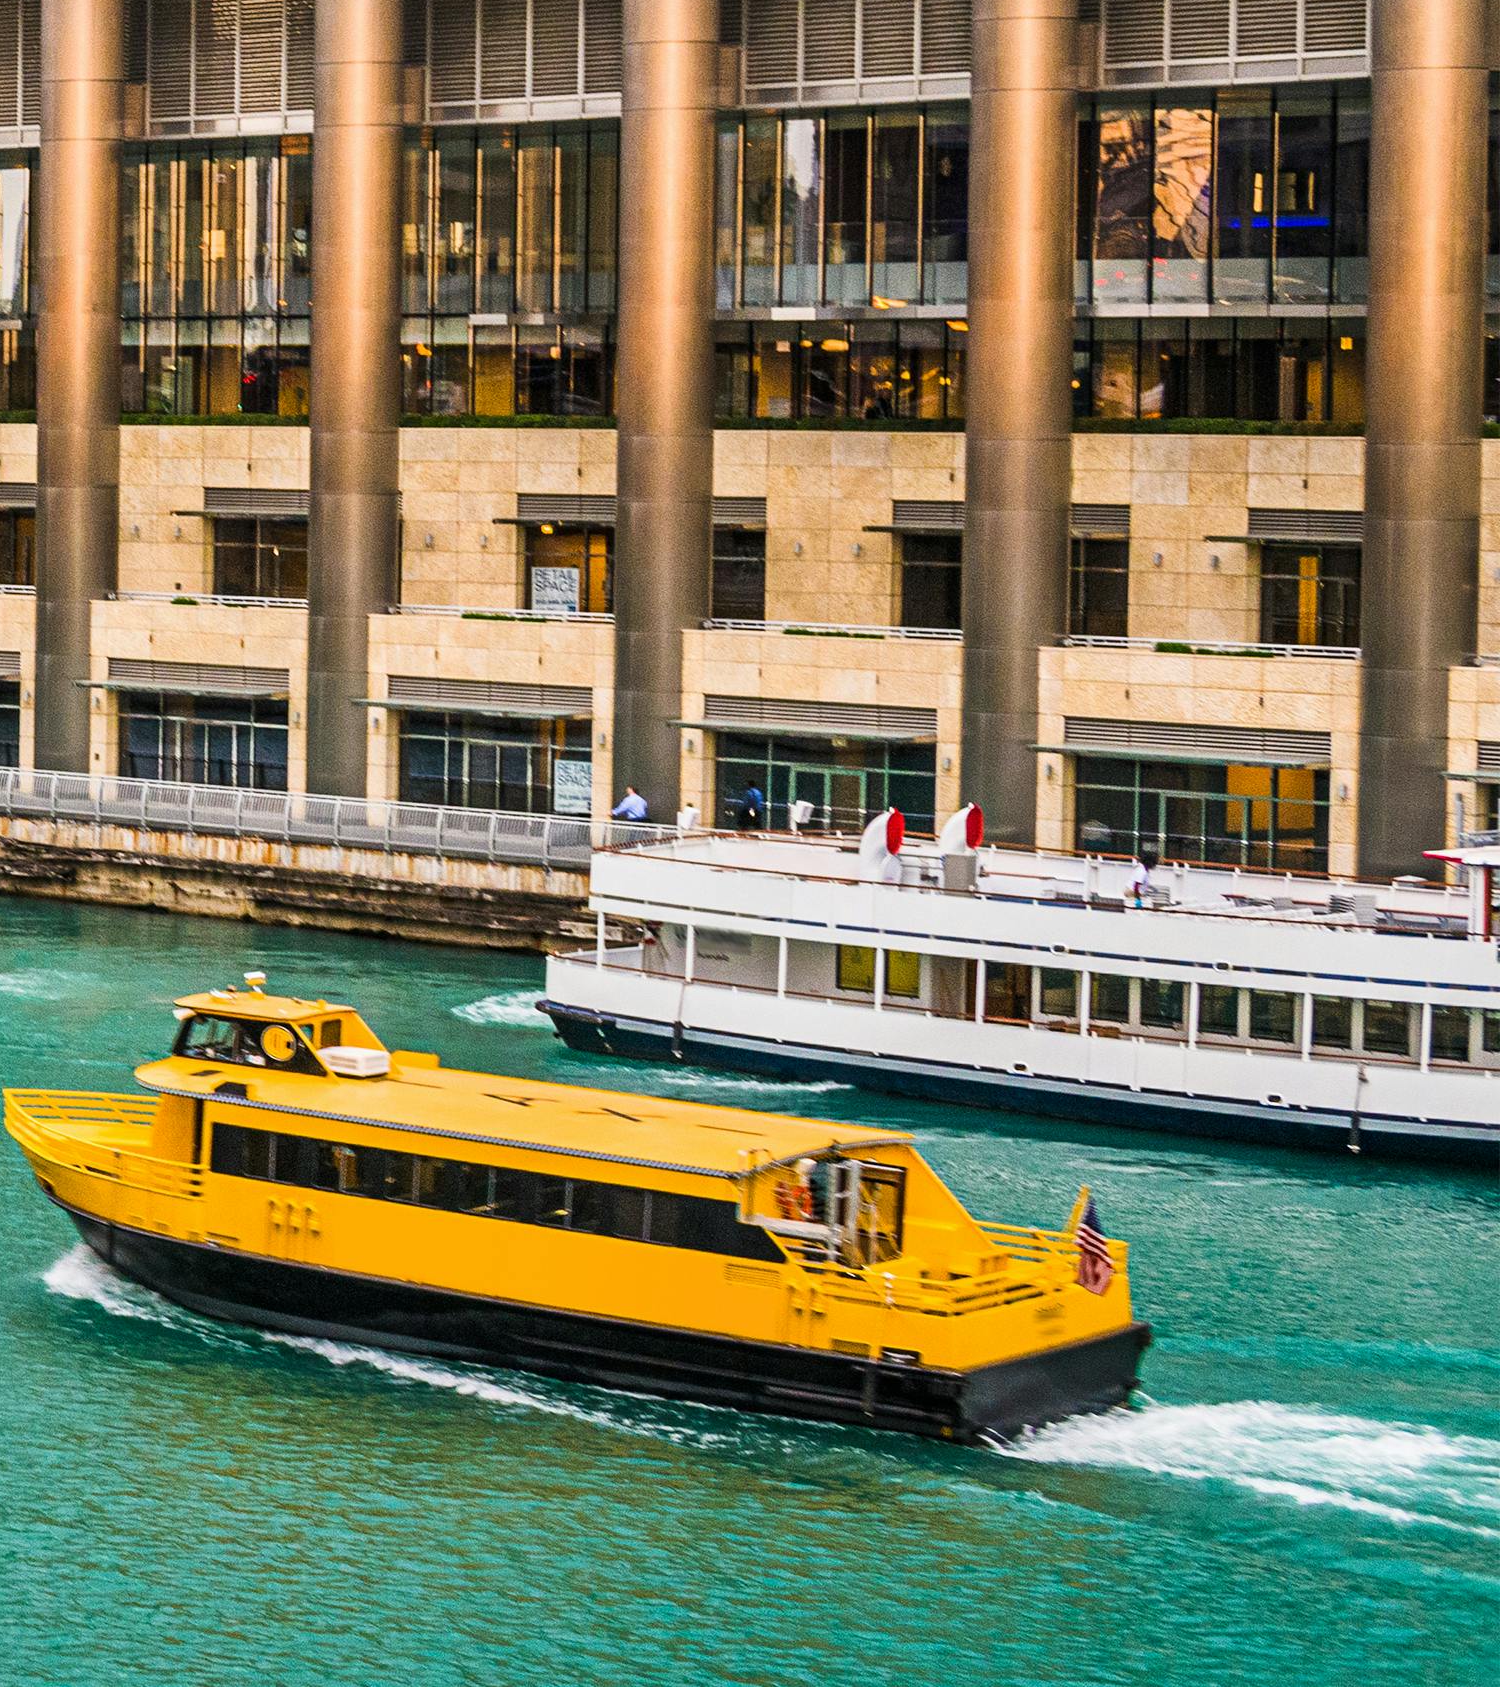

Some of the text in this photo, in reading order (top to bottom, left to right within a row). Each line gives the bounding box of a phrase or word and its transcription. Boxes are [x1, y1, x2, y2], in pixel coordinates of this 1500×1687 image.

[534, 568, 576, 581] RETAIL
[534, 579, 576, 593] SPACE
[557, 762, 592, 775] RETAI
